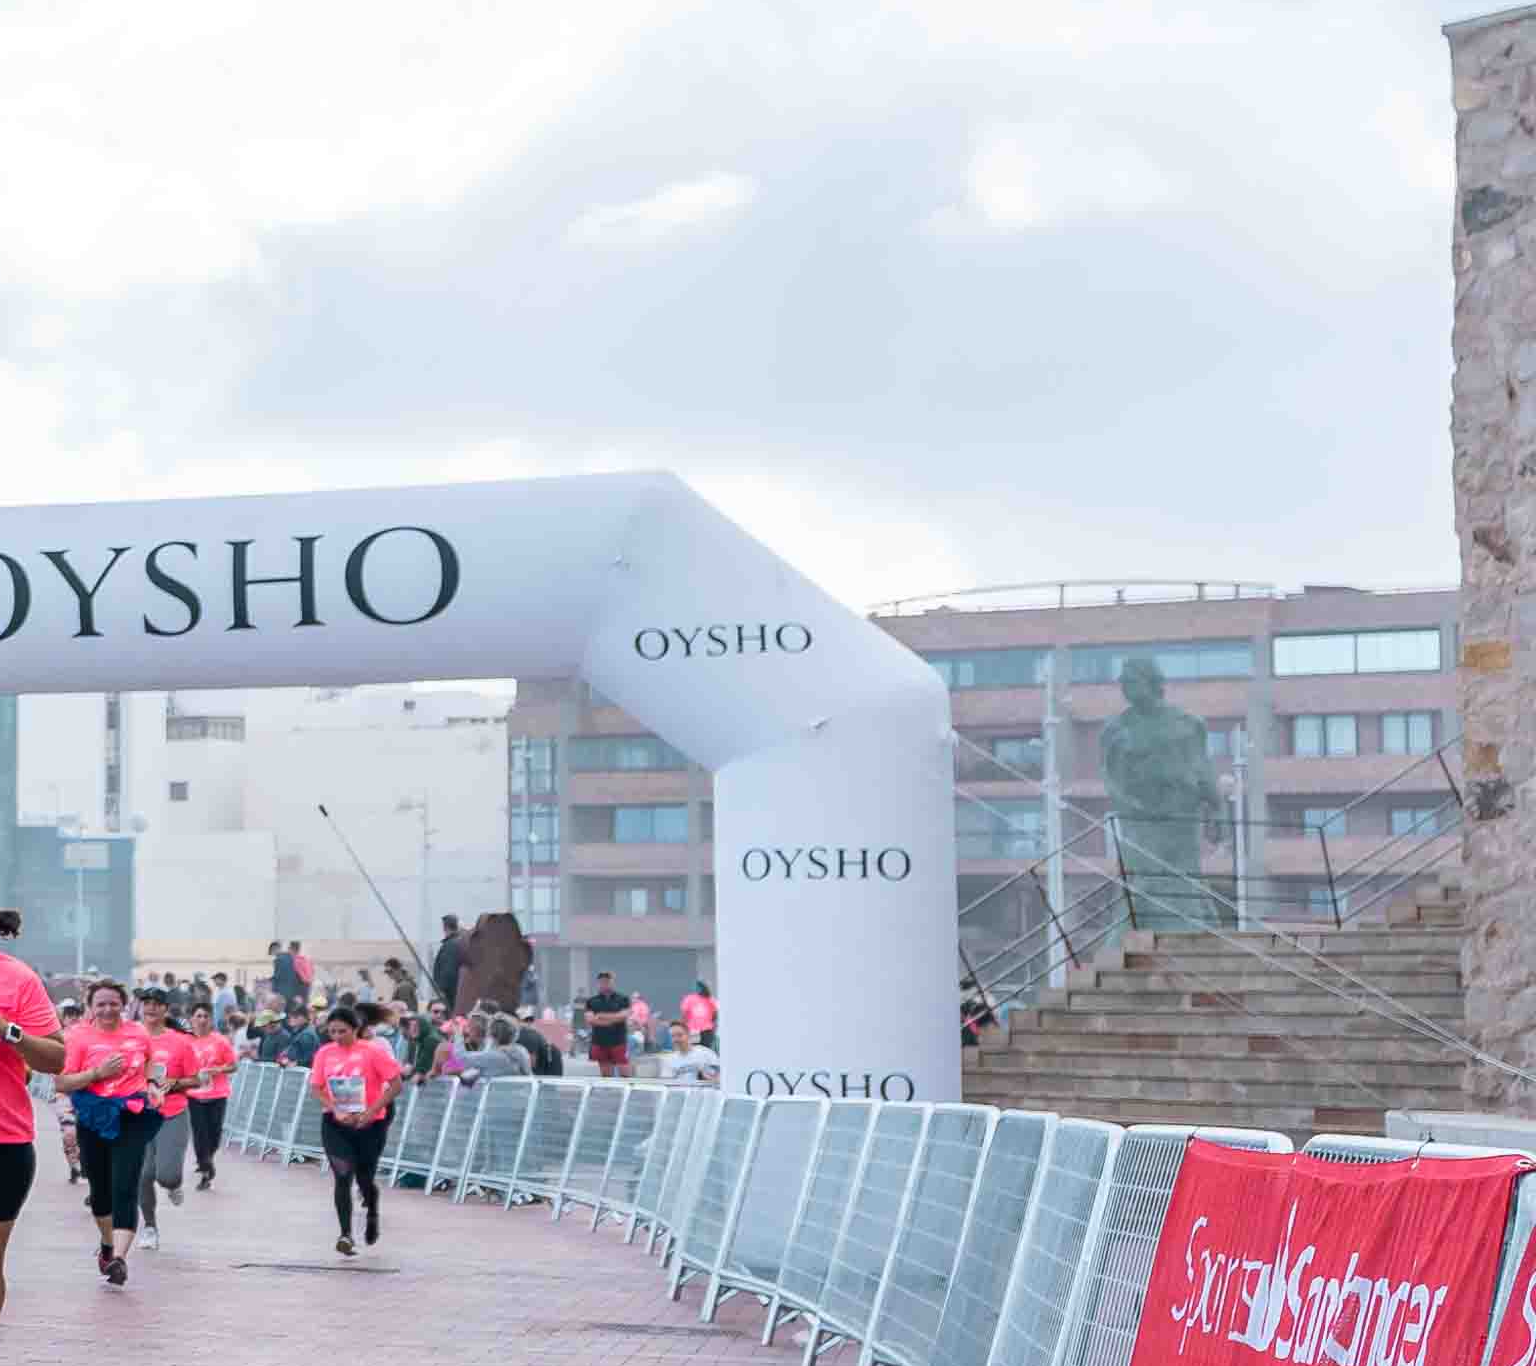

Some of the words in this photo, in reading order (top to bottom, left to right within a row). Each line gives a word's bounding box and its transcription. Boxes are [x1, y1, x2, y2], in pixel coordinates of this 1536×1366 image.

[633, 622, 813, 662] OYSHO
[742, 847, 912, 883] OYSHO
[745, 1069, 917, 1102] OYSHO
